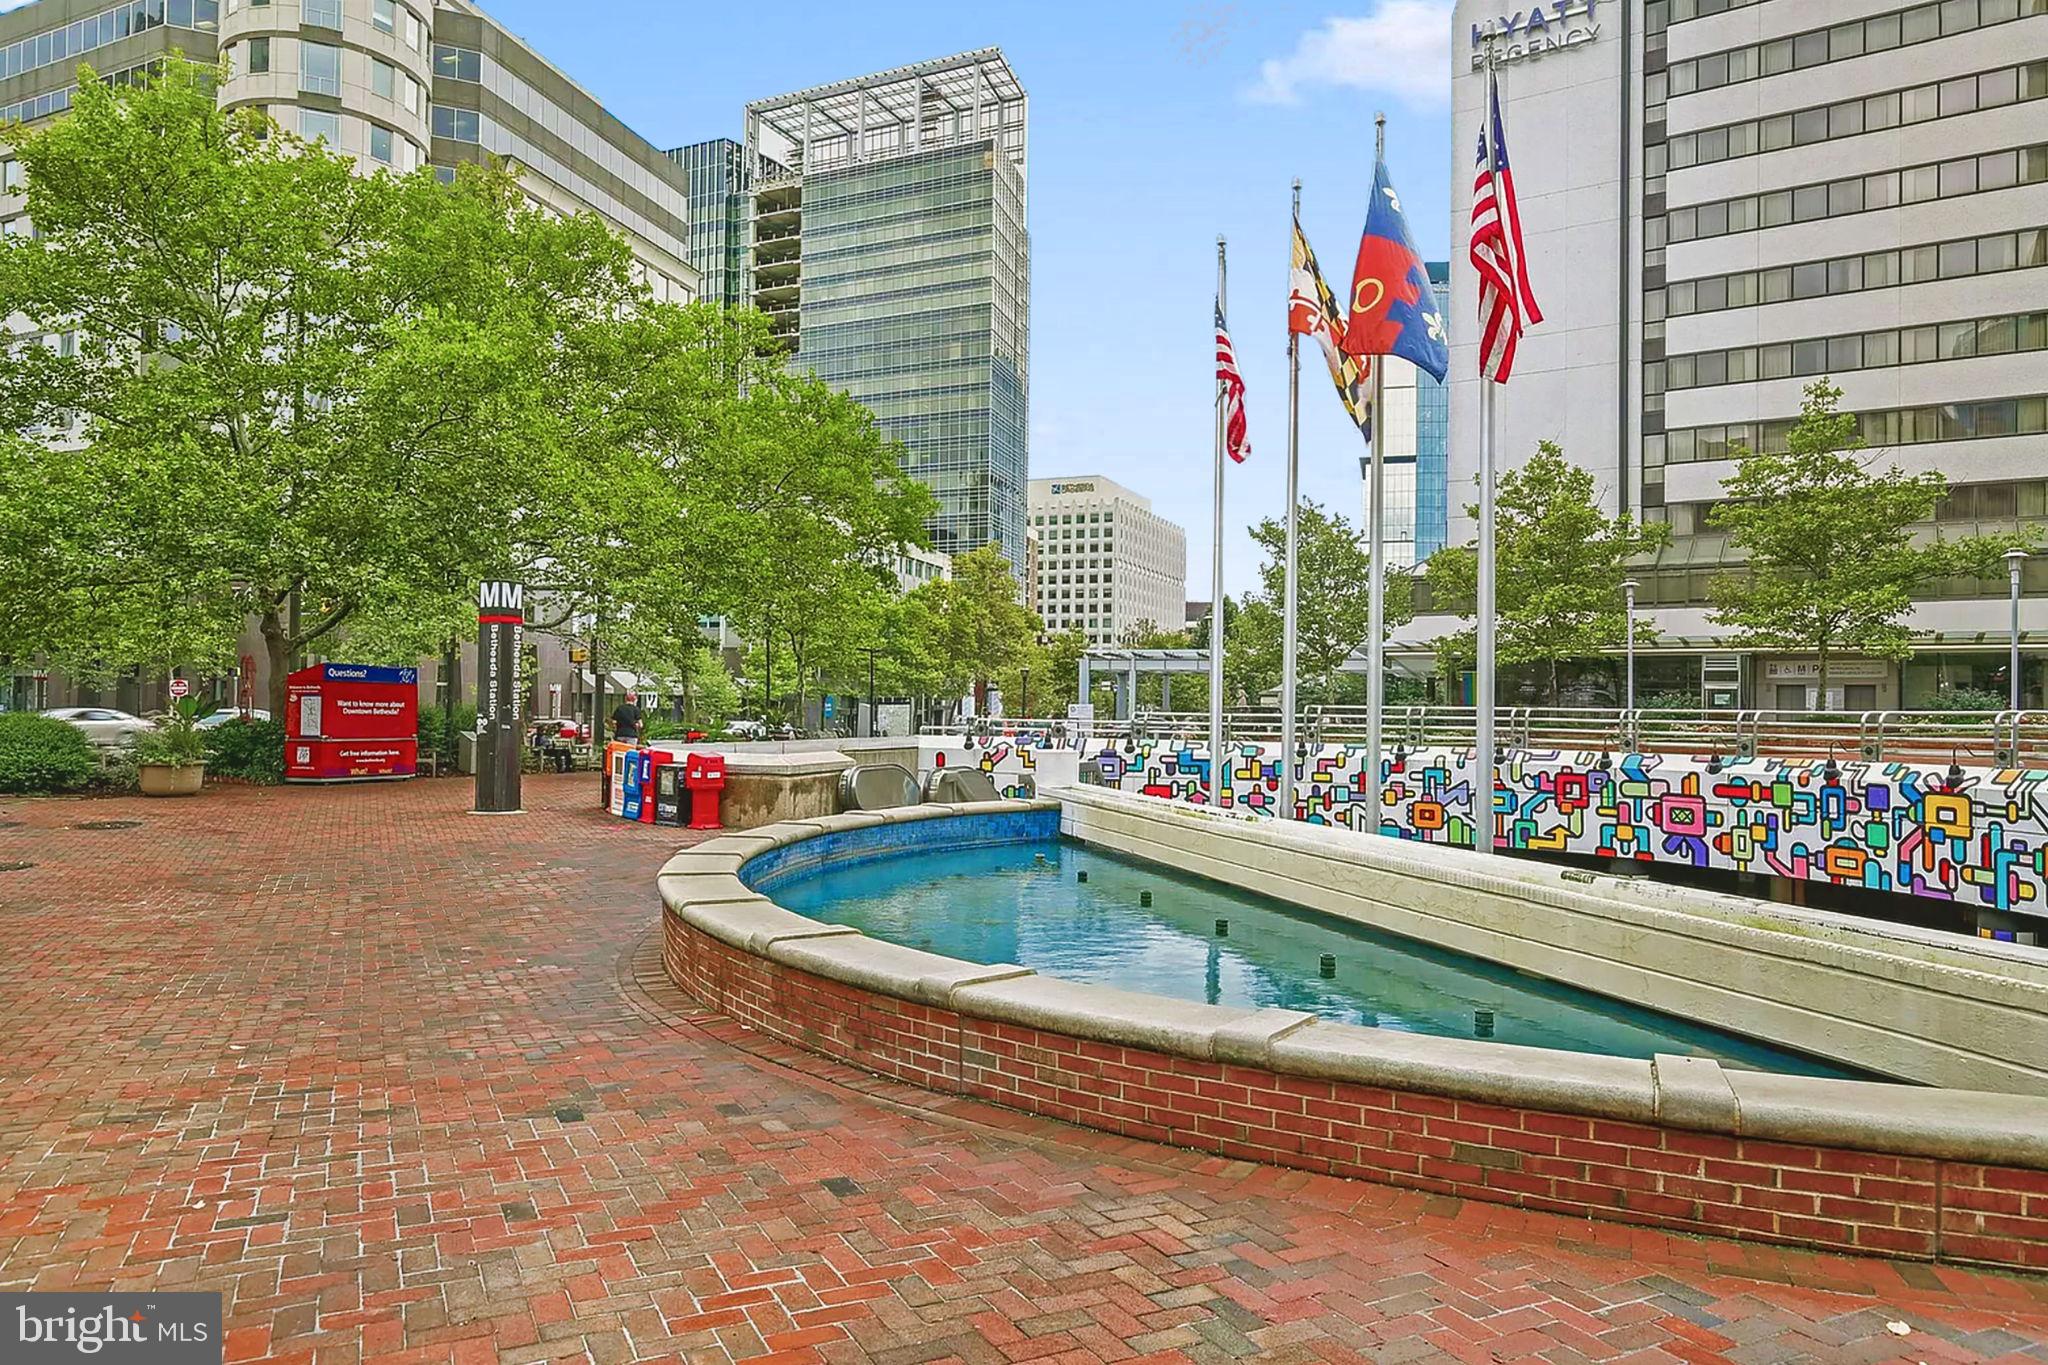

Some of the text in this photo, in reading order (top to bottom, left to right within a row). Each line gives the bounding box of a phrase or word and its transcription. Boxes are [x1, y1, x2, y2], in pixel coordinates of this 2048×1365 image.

[328, 667, 367, 678] Questions?
[489, 624, 499, 720] Bethesda Station
[513, 625, 522, 720] Bethesda Station
